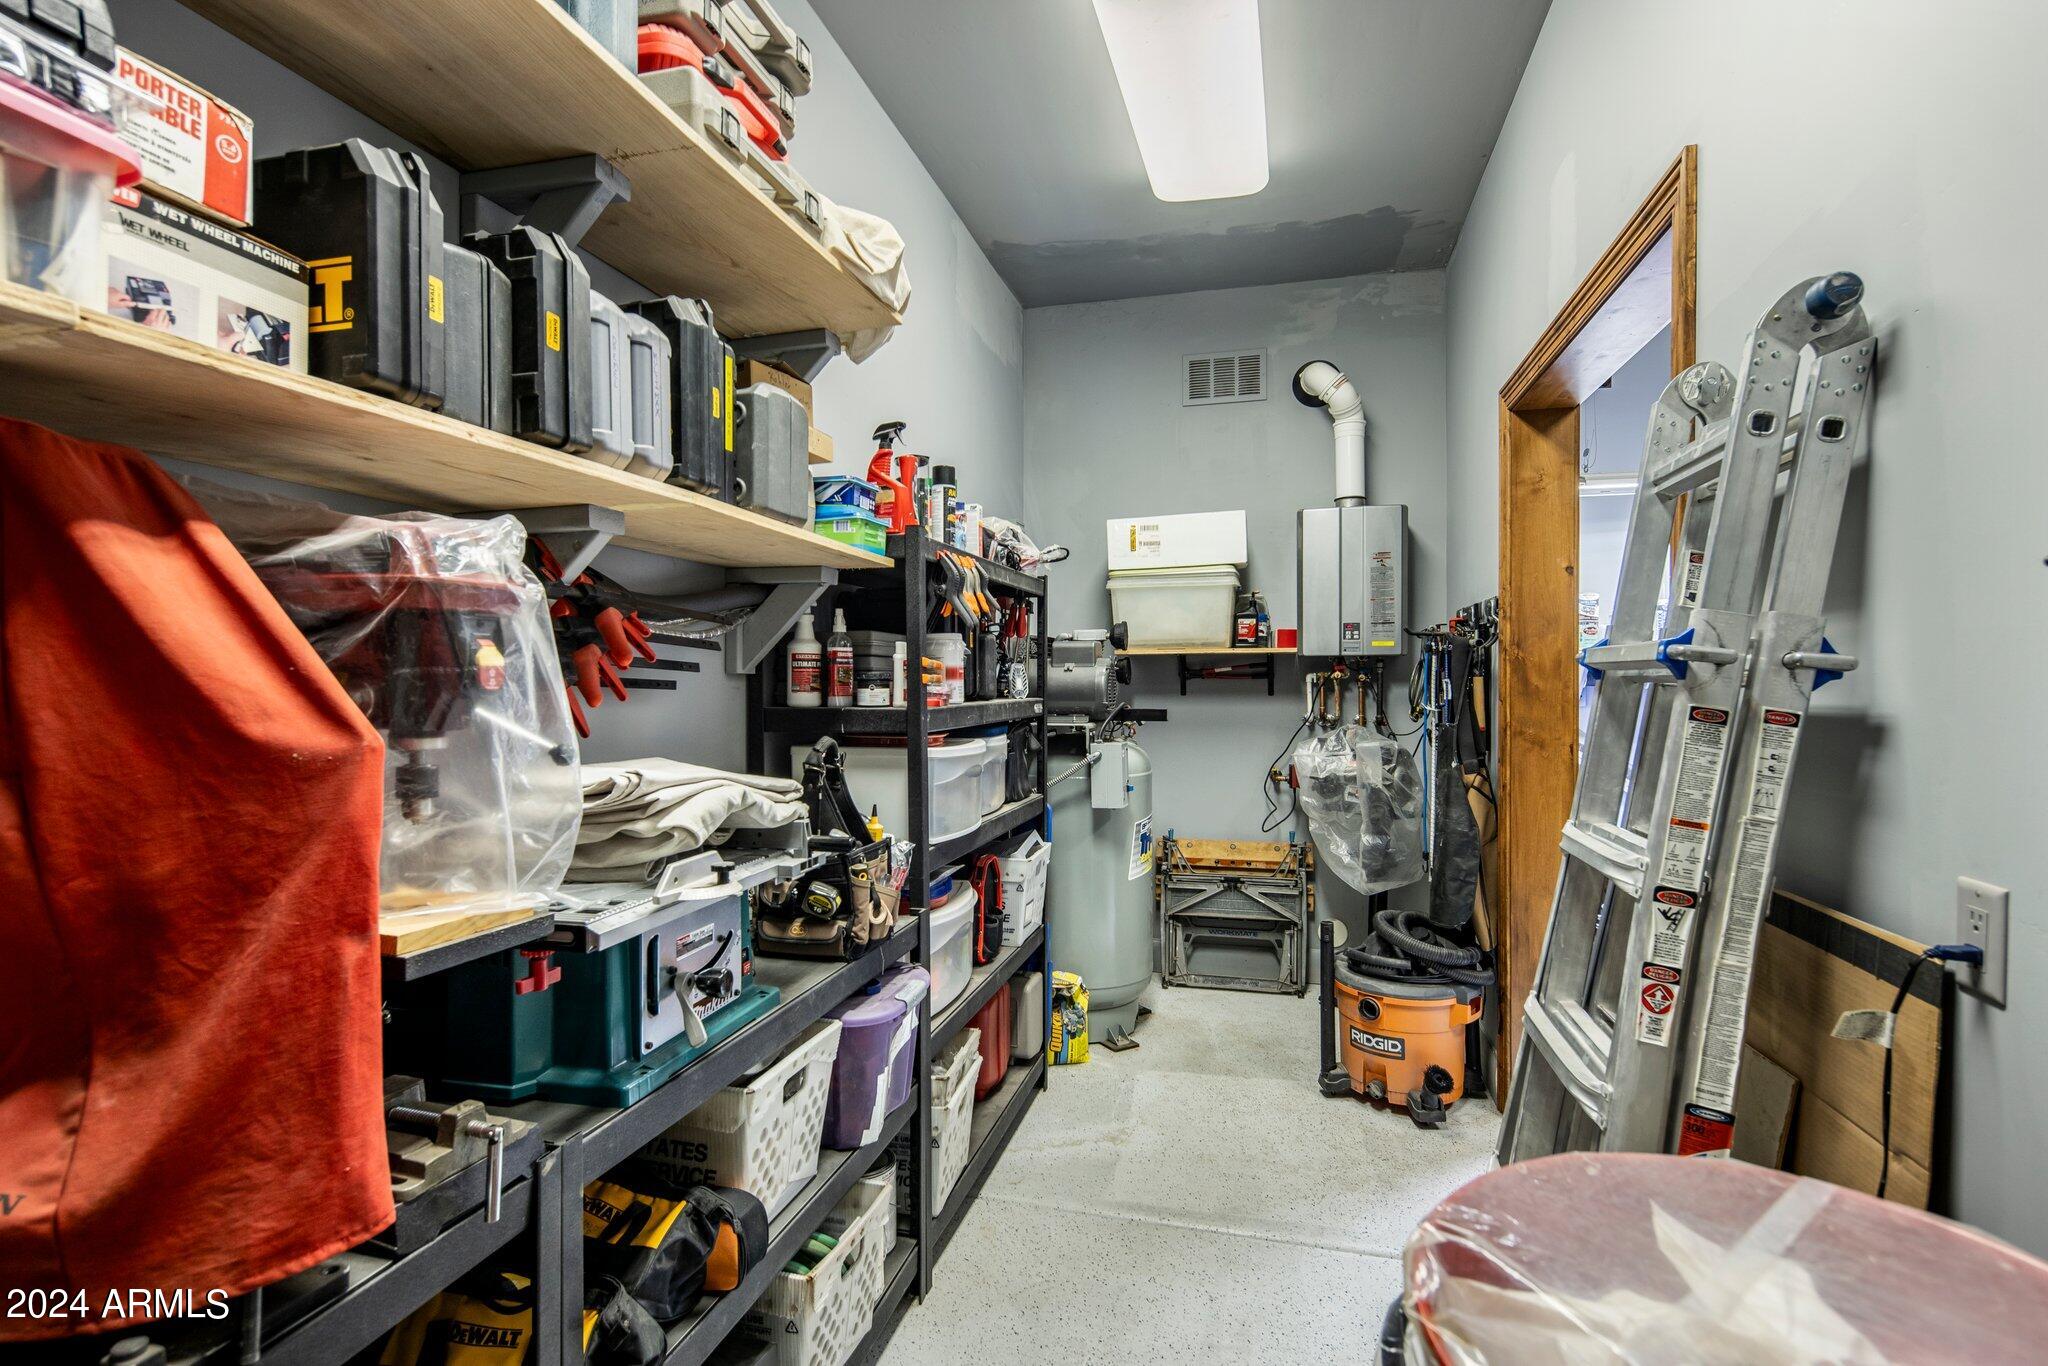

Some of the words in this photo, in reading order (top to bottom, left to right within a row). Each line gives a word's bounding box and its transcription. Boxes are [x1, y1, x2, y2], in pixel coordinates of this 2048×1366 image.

[119, 58, 202, 119] PORTER
[150, 107, 202, 140] ABLE
[118, 211, 144, 233] WET
[149, 227, 190, 252] WHEEL
[153, 201, 188, 224] WET
[190, 216, 240, 248] WHEEL
[242, 239, 300, 274] MACHINE
[1766, 714, 1794, 722] DANGER
[1208, 928, 1258, 937] WORKMATE
[1351, 1029, 1402, 1052] RIDGID
